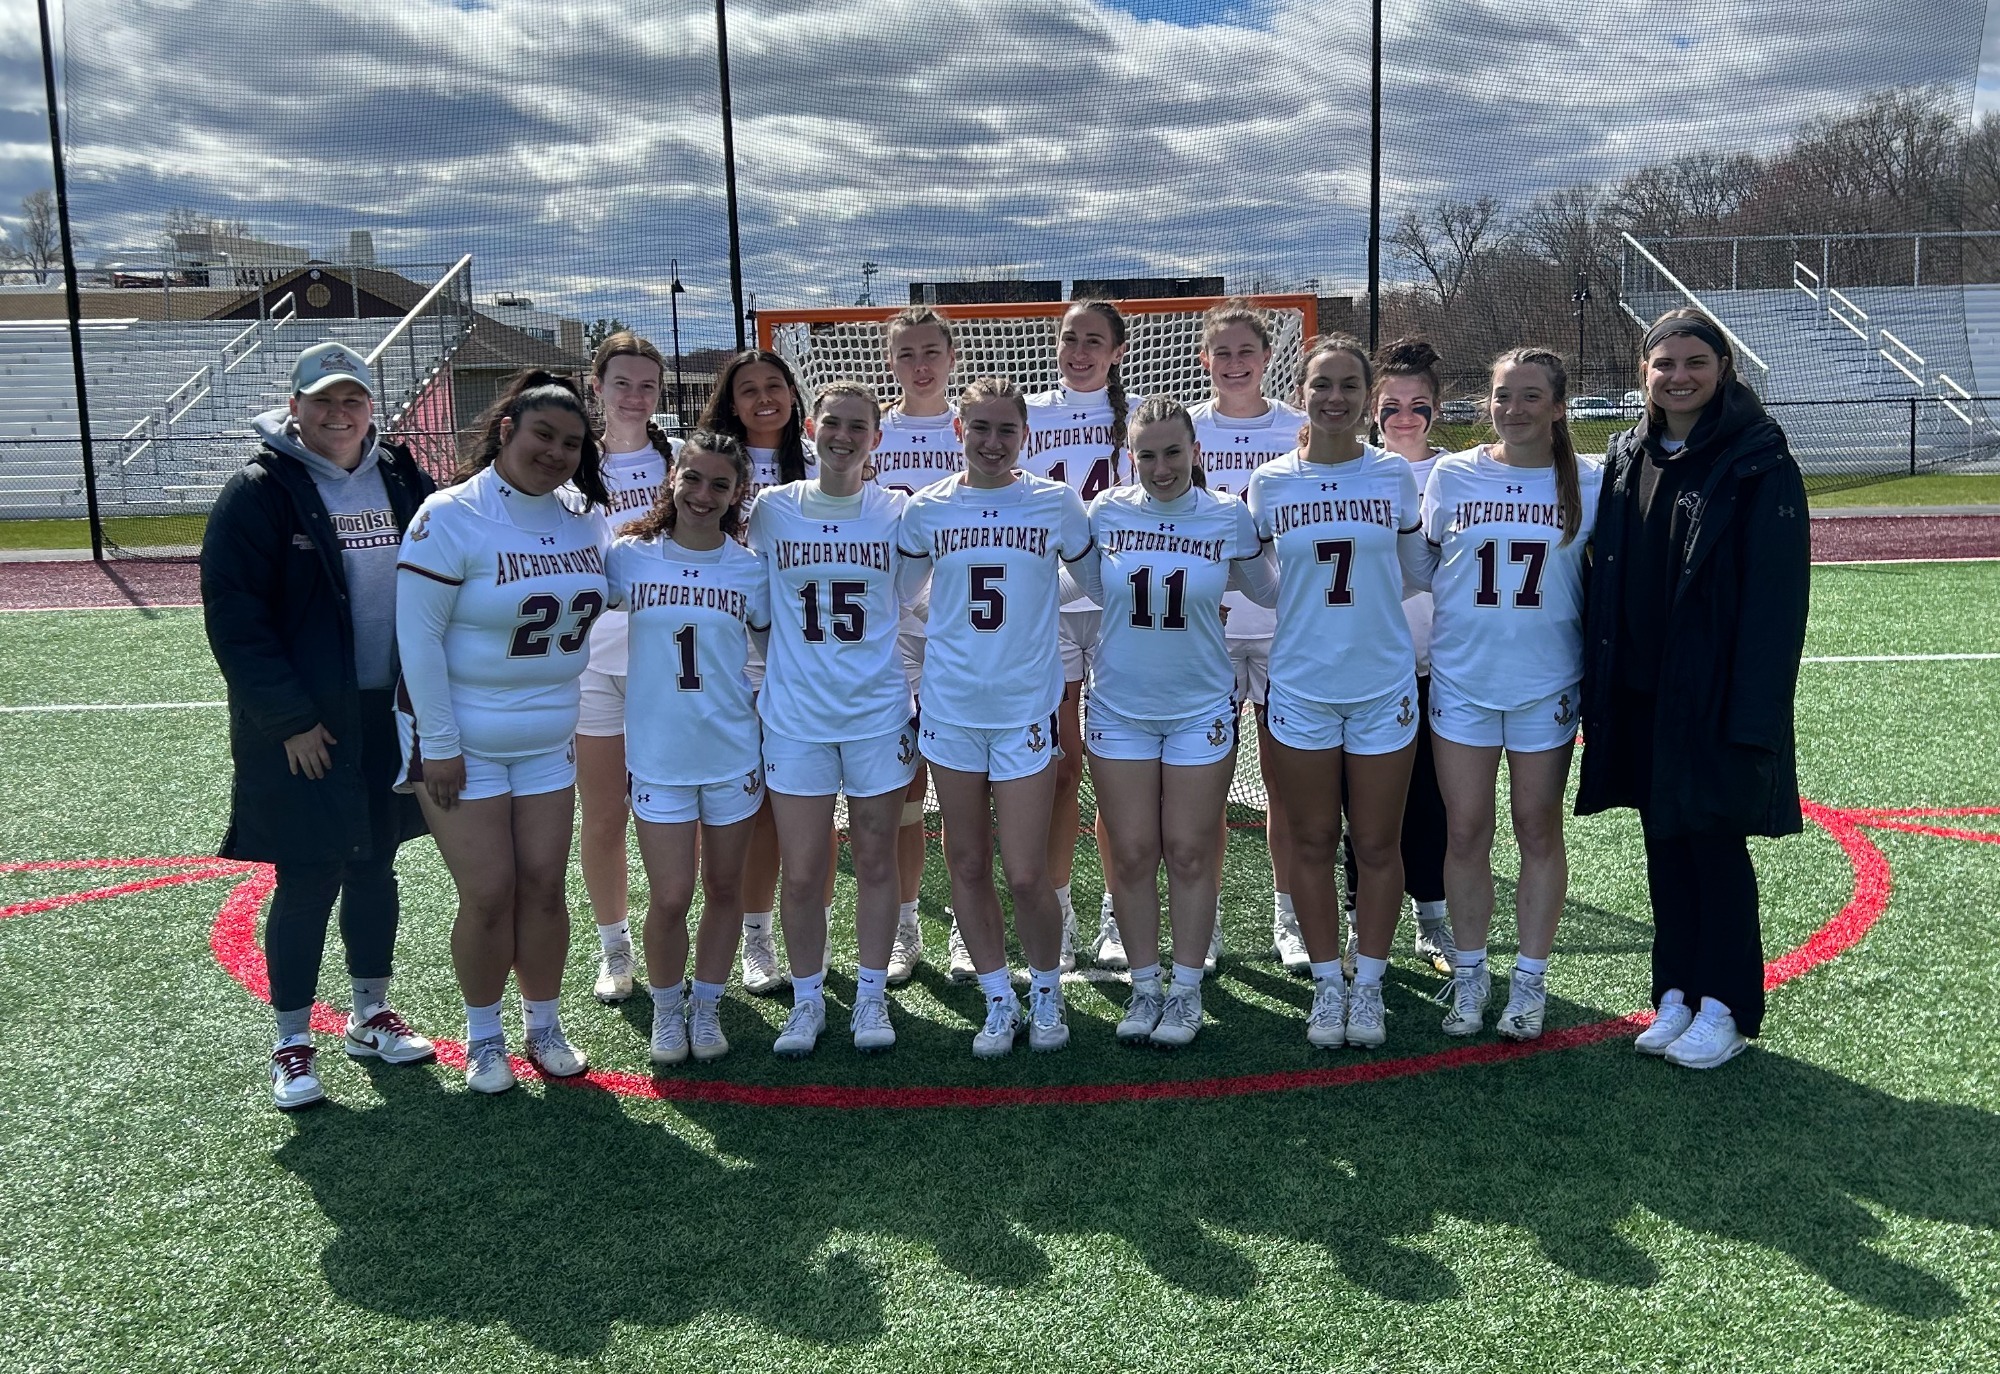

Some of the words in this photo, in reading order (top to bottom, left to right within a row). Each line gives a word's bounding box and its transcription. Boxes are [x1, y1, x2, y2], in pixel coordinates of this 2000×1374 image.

[1027, 426, 1115, 460] ANCHORWOM
[1275, 500, 1393, 536] ANCHORWOMEN
[1454, 501, 1565, 533] ANCHORWOME
[776, 540, 890, 572] ANCHORWOMEN
[934, 526, 1048, 560] ANCHORWOMEN
[1106, 529, 1224, 563] ANCHORWOMEN
[495, 545, 605, 587] ANCHORWOMEN
[1312, 537, 1355, 607] 7
[1474, 538, 1549, 609] 17
[630, 582, 747, 622] ANCHORWOMEN
[797, 579, 868, 644] 15
[967, 564, 1007, 633] 5
[1127, 565, 1188, 631] 11
[506, 588, 604, 659] 23
[673, 623, 704, 692] 1
